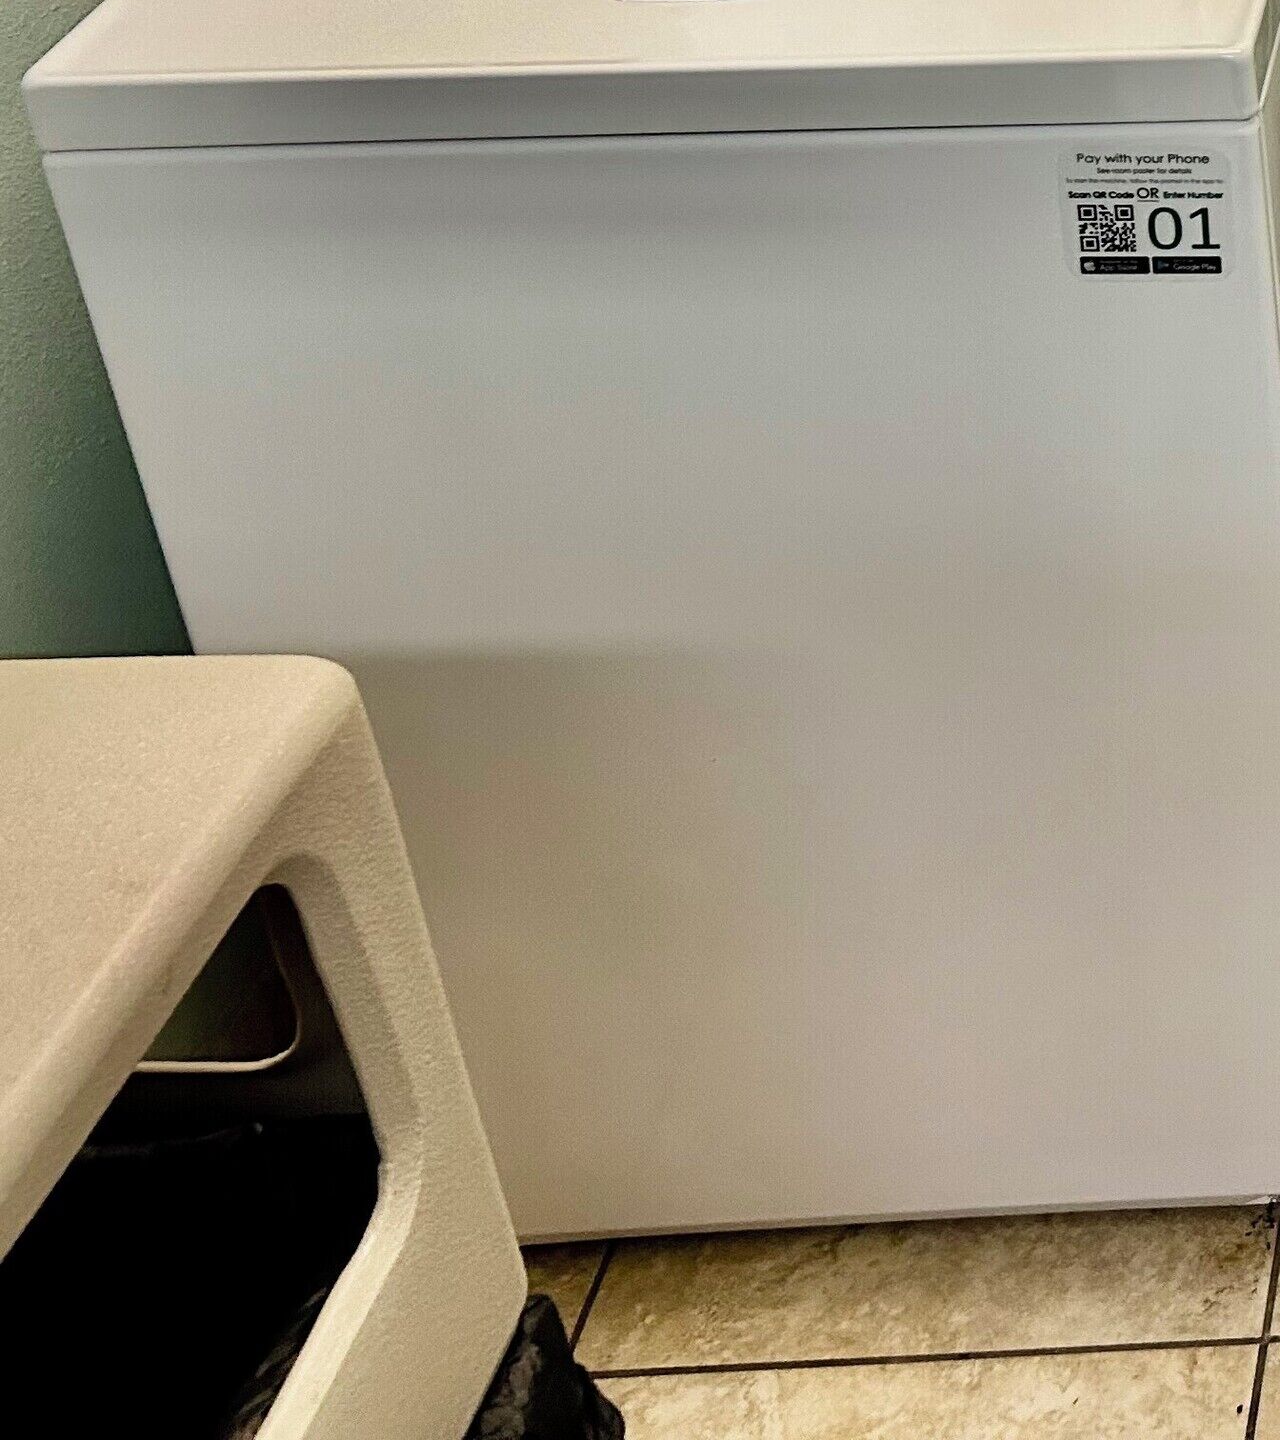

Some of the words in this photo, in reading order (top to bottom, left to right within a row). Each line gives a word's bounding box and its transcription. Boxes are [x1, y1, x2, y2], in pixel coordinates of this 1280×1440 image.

[1076, 152, 1101, 165] Pay
[1104, 153, 1132, 163] with
[1135, 155, 1164, 166] your
[1167, 153, 1210, 164] Phone
[1068, 190, 1092, 199] Scan
[1092, 190, 1107, 199] QR
[1108, 190, 1135, 199] Code
[1137, 187, 1159, 199] OR
[1163, 190, 1186, 199] Enter
[1187, 191, 1224, 199] Number
[1147, 206, 1221, 250] 01
